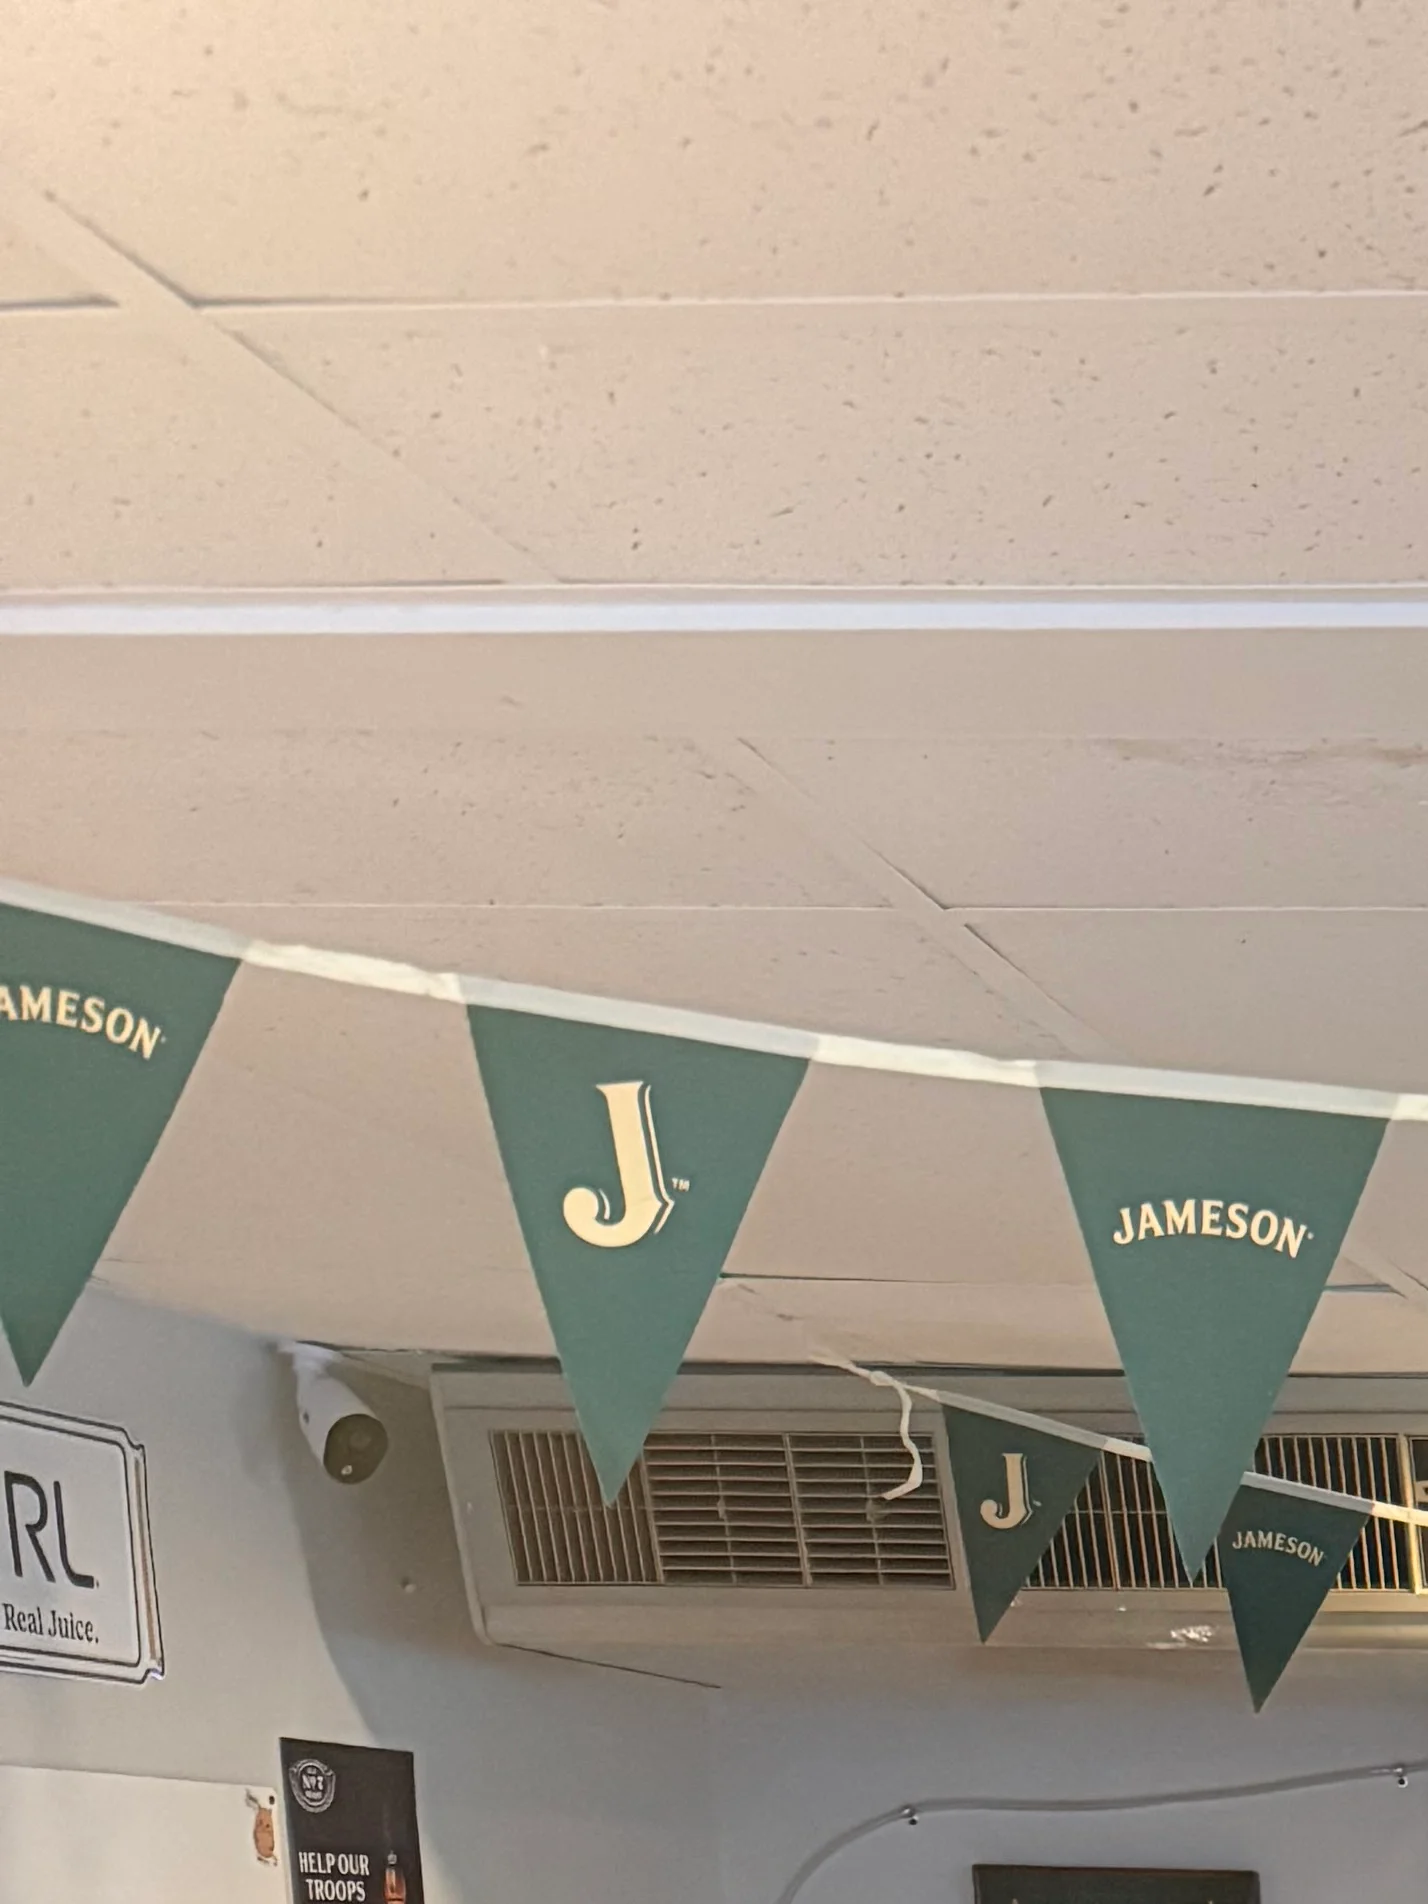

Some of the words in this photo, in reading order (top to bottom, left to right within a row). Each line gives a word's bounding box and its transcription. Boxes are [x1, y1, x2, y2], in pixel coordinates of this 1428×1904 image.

[0, 985, 161, 1061] AMESON
[563, 1081, 674, 1248] J
[1113, 1199, 1306, 1259] JAMESON
[980, 1453, 1033, 1530] J
[1232, 1530, 1325, 1567] JAMESON
[3, 1603, 43, 1637] Real
[48, 1609, 100, 1644] Juice.
[299, 1851, 337, 1875] HELP
[336, 1853, 370, 1876] OUR
[305, 1879, 366, 1902] TROOPS
